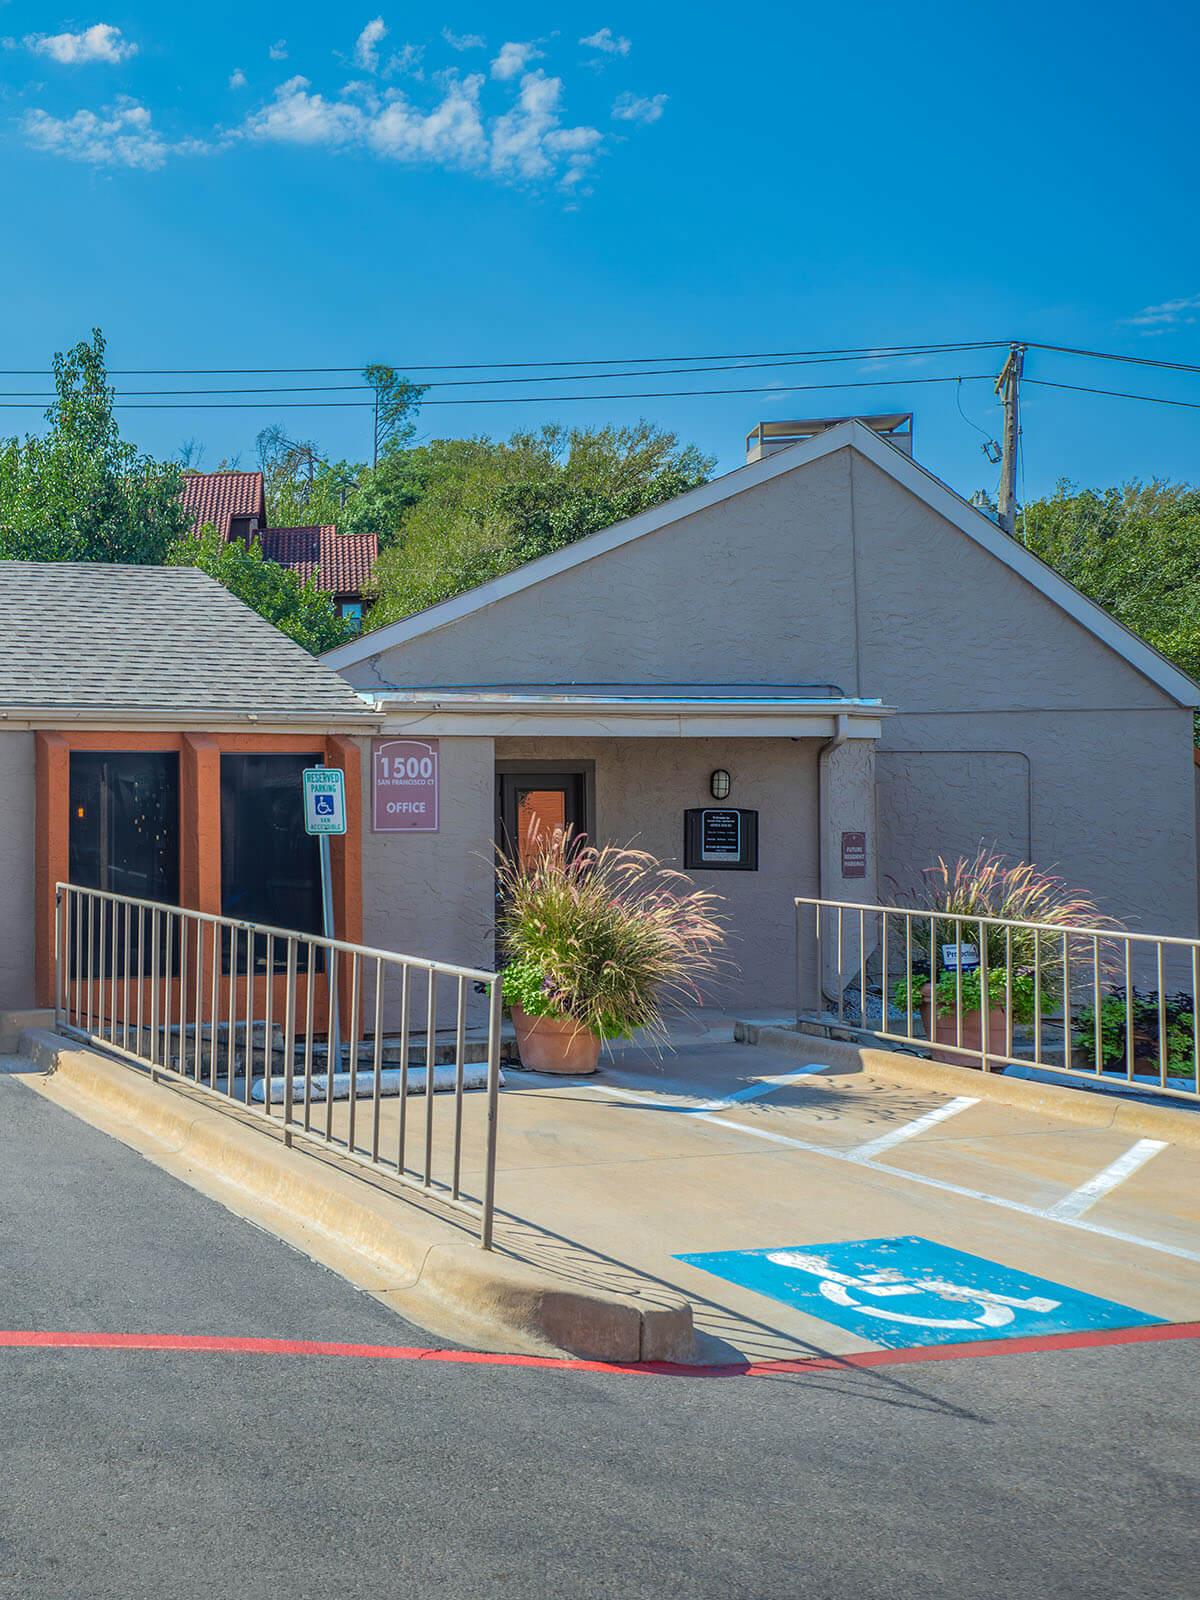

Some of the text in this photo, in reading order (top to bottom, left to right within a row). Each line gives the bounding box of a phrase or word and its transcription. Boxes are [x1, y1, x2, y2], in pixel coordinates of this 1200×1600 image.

[380, 757, 433, 778] 1500
[306, 773, 339, 783] RESERVED
[311, 784, 336, 792] PARKING
[386, 802, 426, 813] OFFICE
